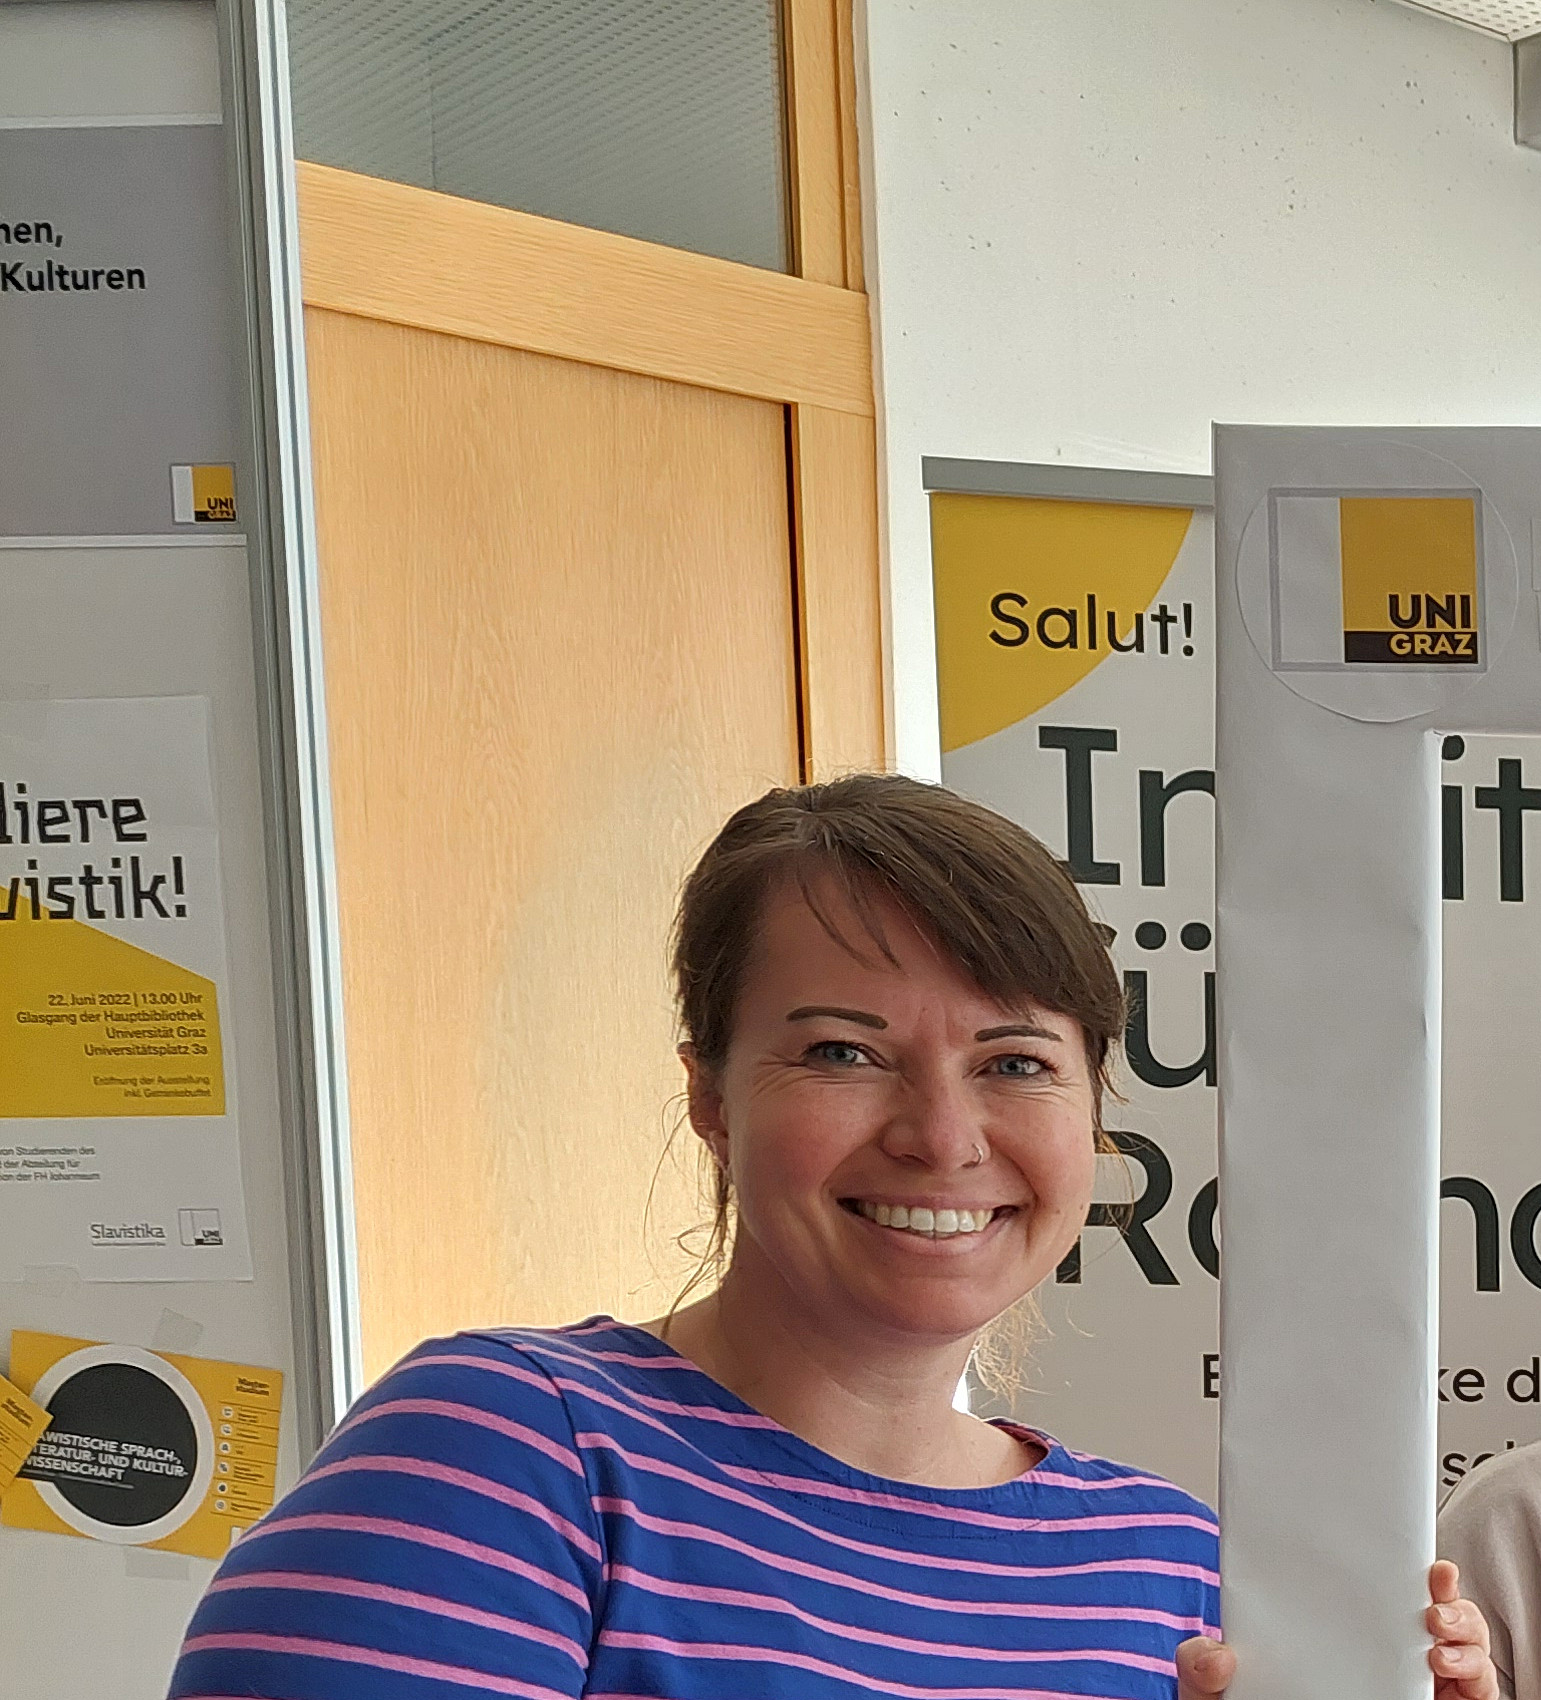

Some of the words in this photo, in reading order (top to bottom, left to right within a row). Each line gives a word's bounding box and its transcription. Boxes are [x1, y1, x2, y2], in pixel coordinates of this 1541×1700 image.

[0, 260, 146, 291] Kulturen
[207, 497, 234, 510] UNI
[1389, 594, 1471, 629] UNI
[987, 592, 1196, 658] Salut!
[1389, 633, 1474, 656] GRAZ
[71, 994, 95, 1006] Juni
[99, 994, 130, 1005] 2022
[17, 1011, 77, 1025] Glasgang
[80, 1011, 100, 1023] der
[177, 1026, 206, 1038] Graz
[91, 1224, 165, 1239] Slavistika
[99, 1454, 129, 1468] UND
